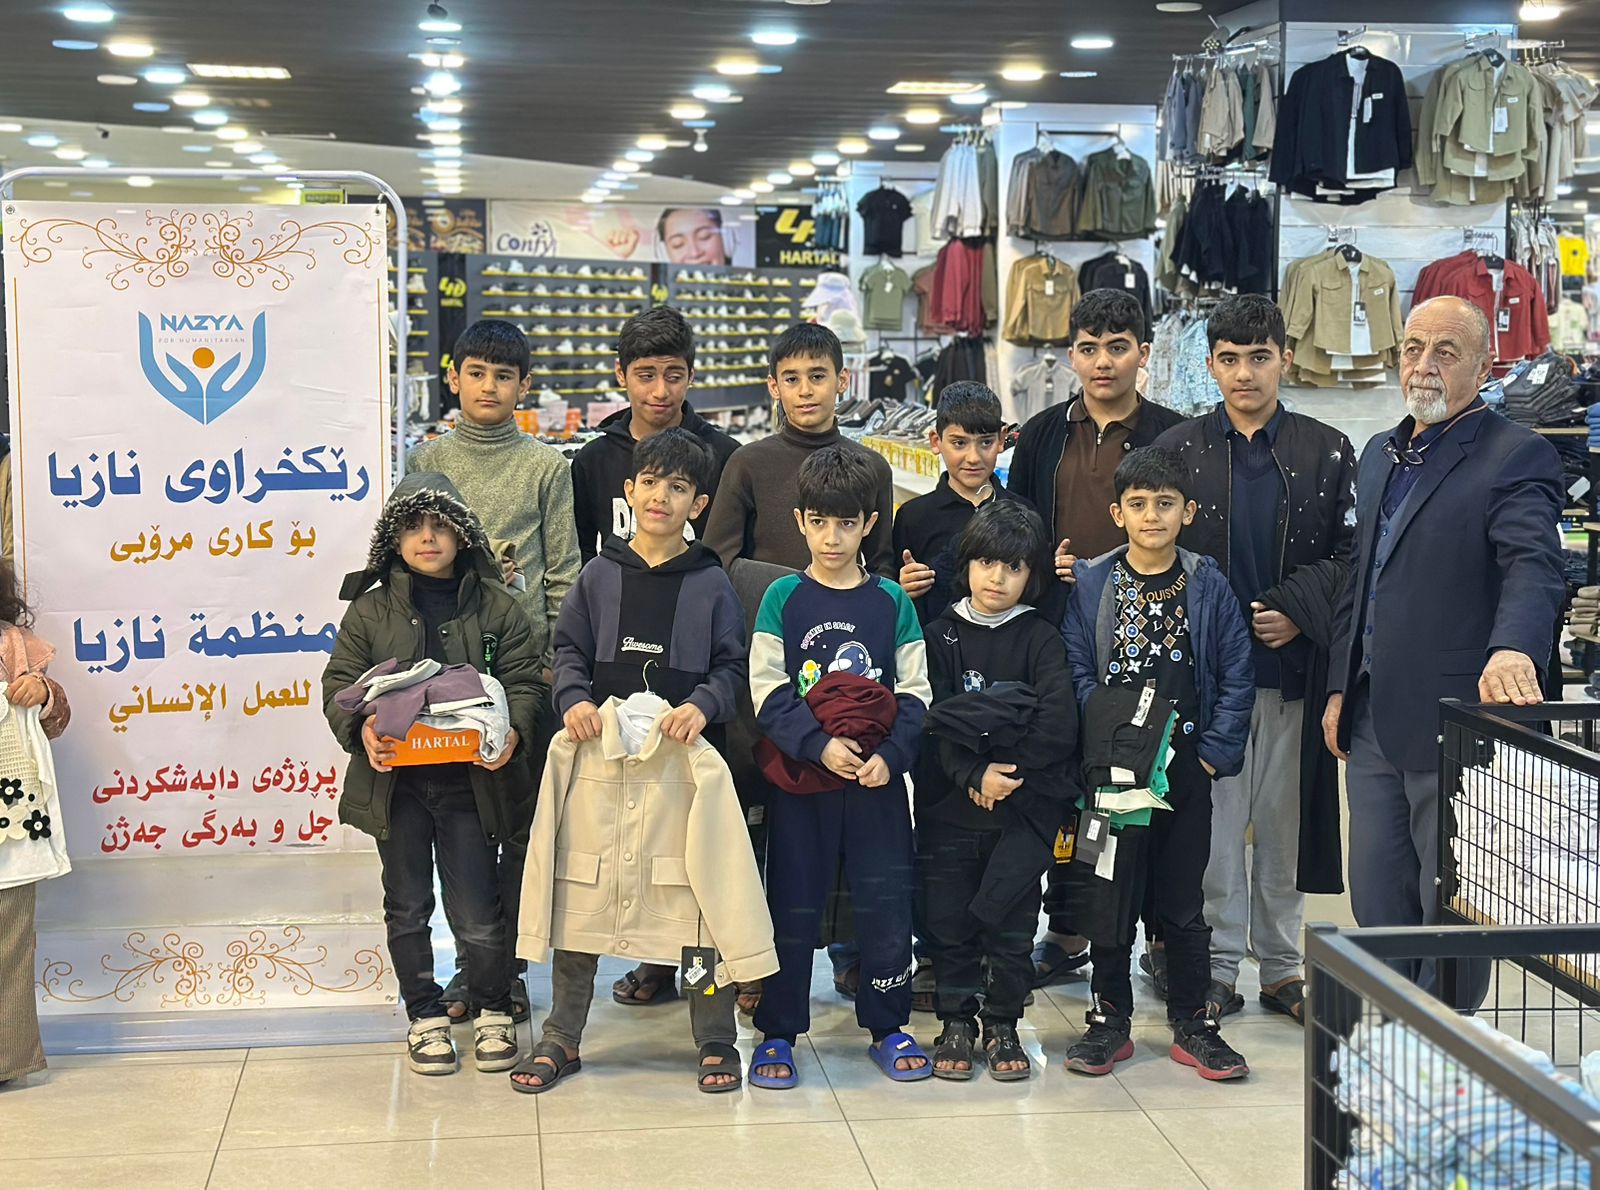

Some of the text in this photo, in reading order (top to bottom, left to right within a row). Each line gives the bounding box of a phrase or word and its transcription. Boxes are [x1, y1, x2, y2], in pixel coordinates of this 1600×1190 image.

[779, 250, 839, 265] HARTAL
[160, 312, 244, 333] NAZYA
[285, 520, 316, 559] بۆ
[187, 611, 338, 659] منظمة
[621, 636, 664, 653] Awesome
[108, 678, 312, 733] للعمل الإنساني
[411, 735, 470, 750] HARTAL
[267, 818, 285, 843] و
[298, 810, 333, 842] جل
